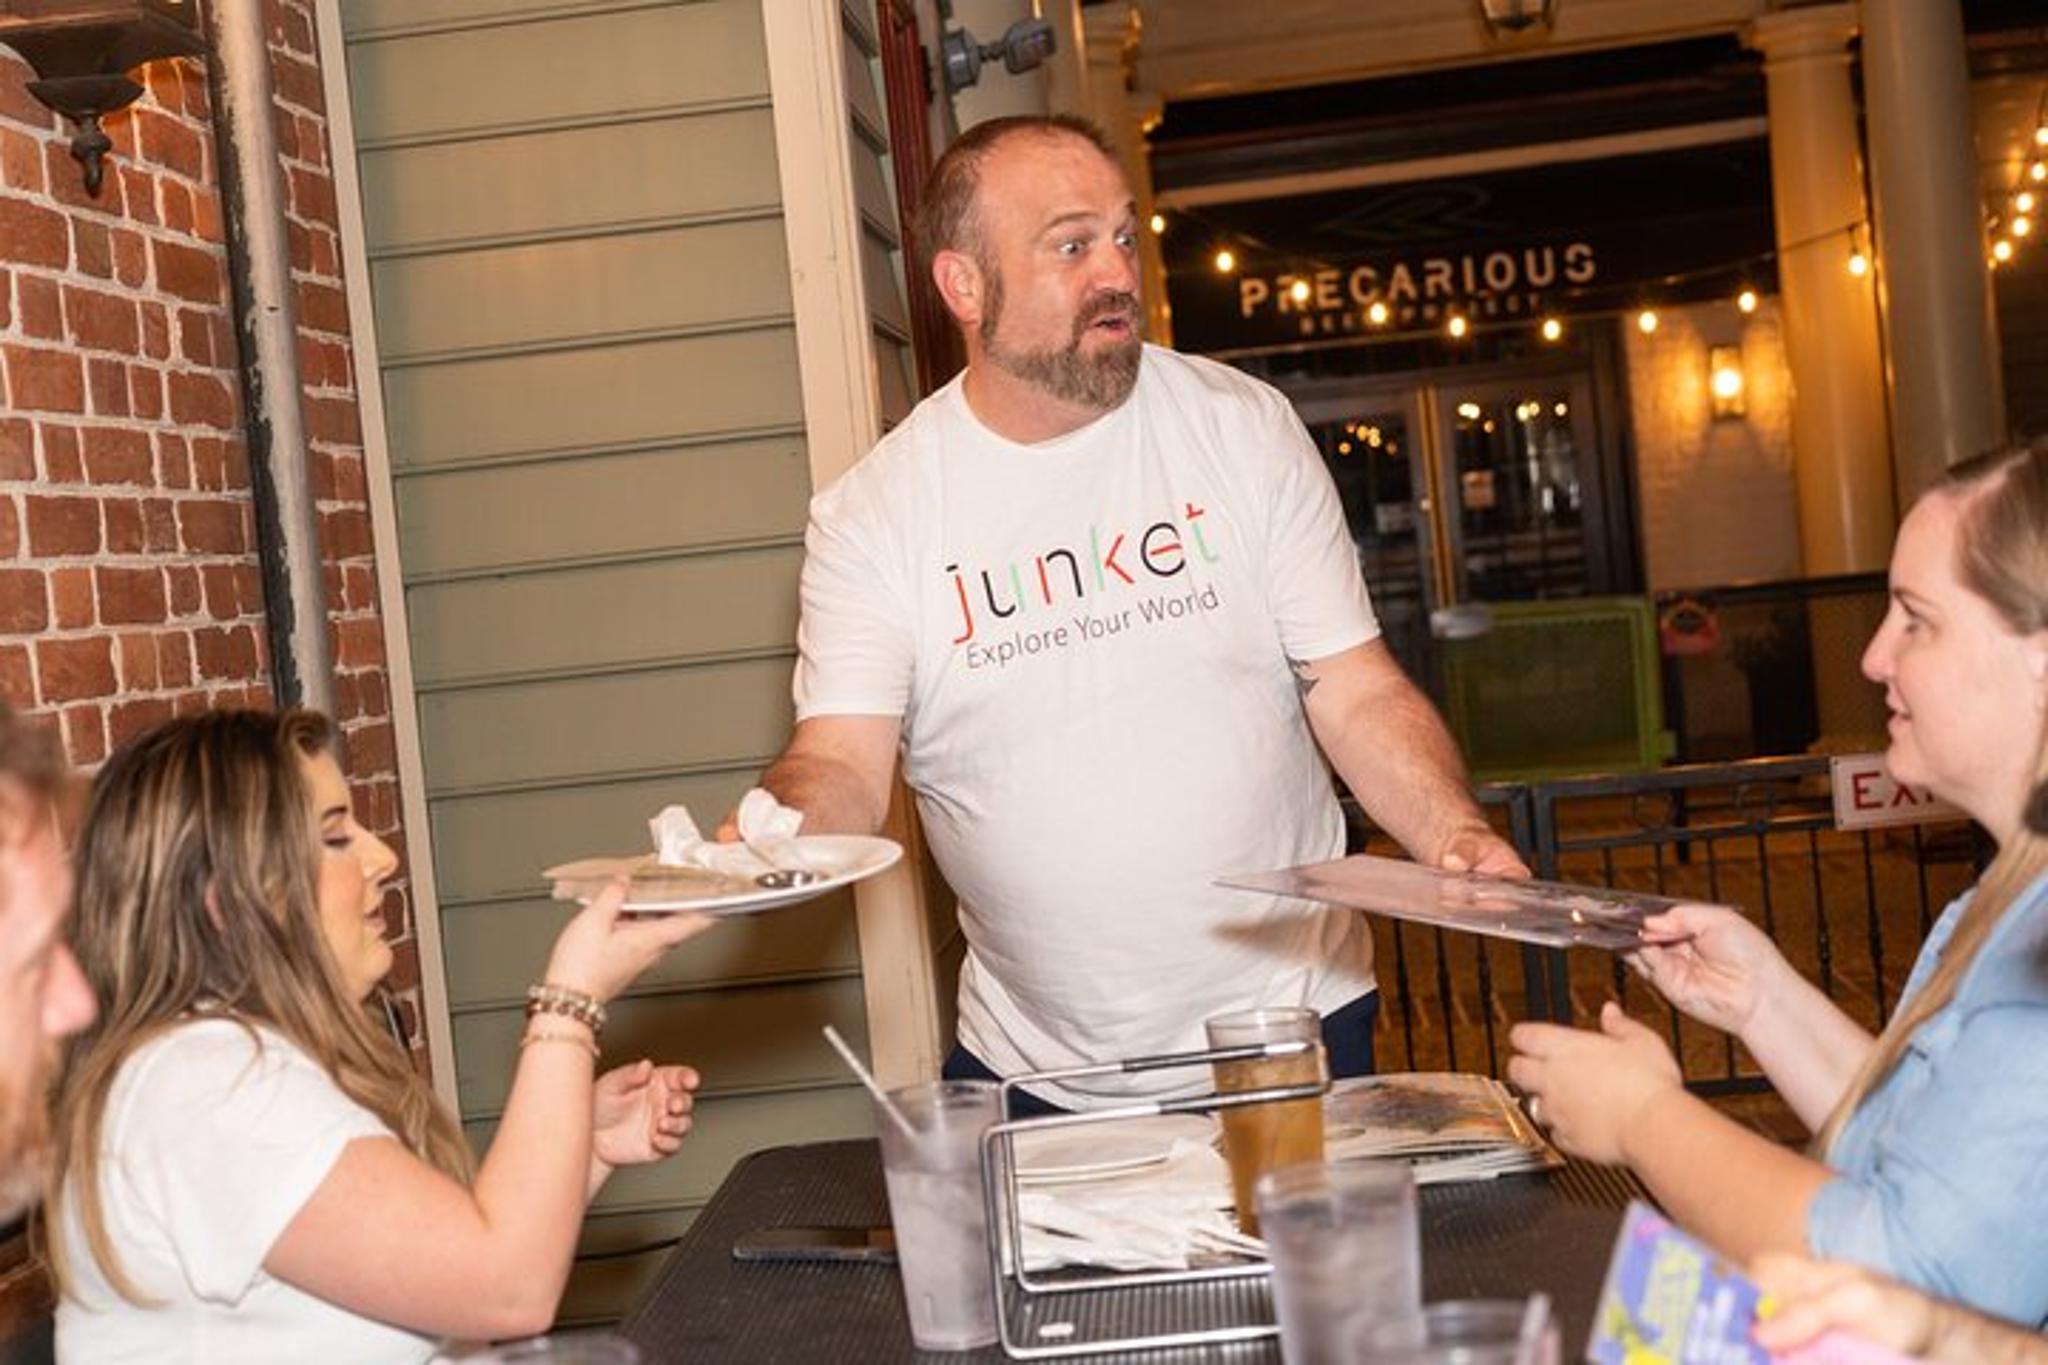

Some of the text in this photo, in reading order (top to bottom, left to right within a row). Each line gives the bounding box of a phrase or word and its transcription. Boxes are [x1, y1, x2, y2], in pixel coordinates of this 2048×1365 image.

[1239, 244, 1596, 317] PRECARIOUS
[946, 503, 1219, 645] junket
[966, 583, 1219, 669] Explore Your World
[1852, 772, 1934, 810] EX
